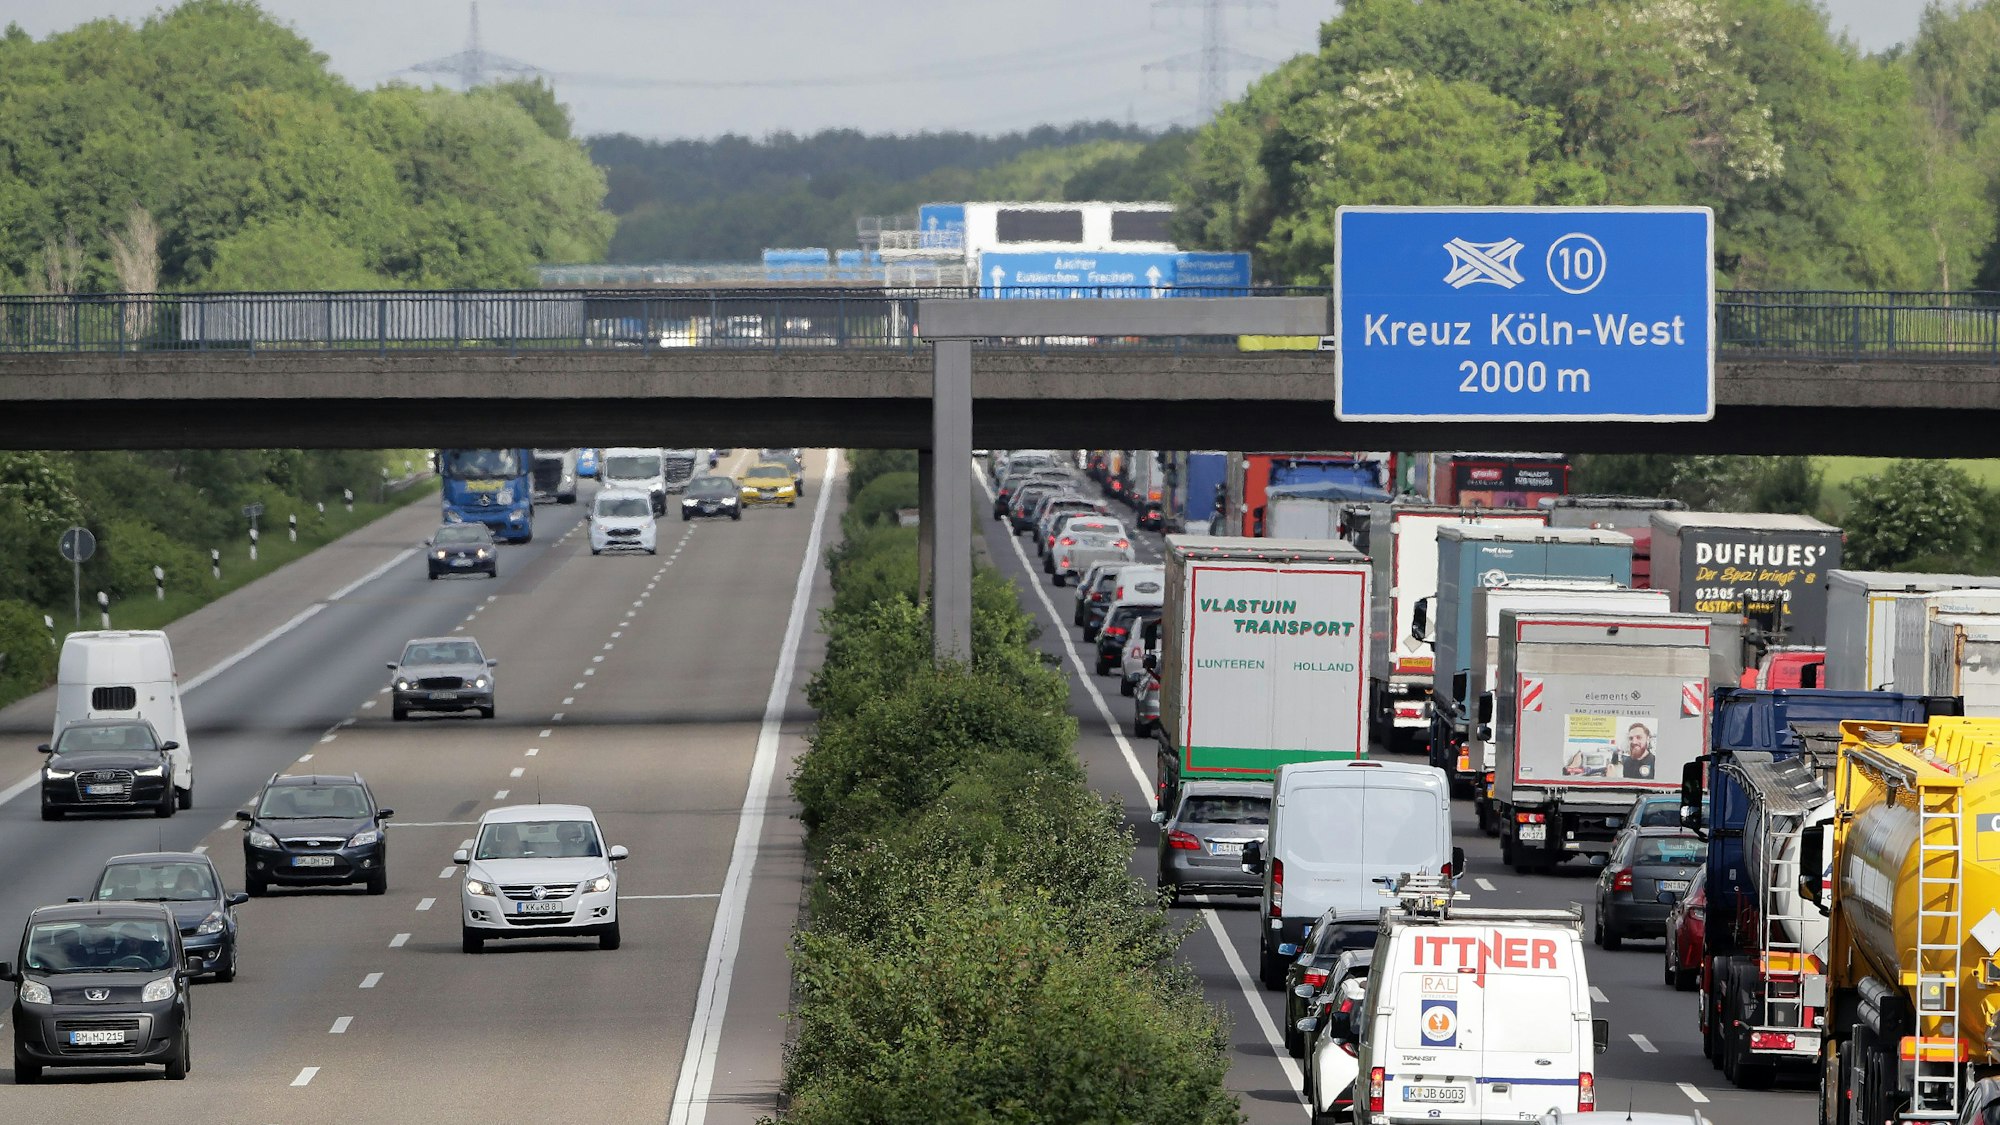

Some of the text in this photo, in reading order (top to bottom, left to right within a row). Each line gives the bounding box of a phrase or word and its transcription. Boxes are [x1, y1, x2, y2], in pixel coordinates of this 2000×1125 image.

[1558, 247, 1594, 281] 10
[1364, 312, 1685, 346] Kreuz Köln-West
[1458, 360, 1590, 393] 2000 m
[1695, 566, 1719, 582] Der
[1720, 567, 1758, 584] Spezi
[1695, 587, 1736, 600] 02305
[1200, 598, 1297, 615] VLASTUIN
[1233, 619, 1355, 637] TRANSPORT
[1197, 658, 1354, 673] LUNTEREN HOLLAND
[1585, 691, 1628, 701] elements
[1414, 930, 1557, 988] ITTNER
[1424, 977, 1455, 991] RAL
[75, 1031, 123, 1042] BM MJ 215
[1410, 1088, 1464, 1100] K JB 6003
[1519, 1111, 1538, 1121] Fax
